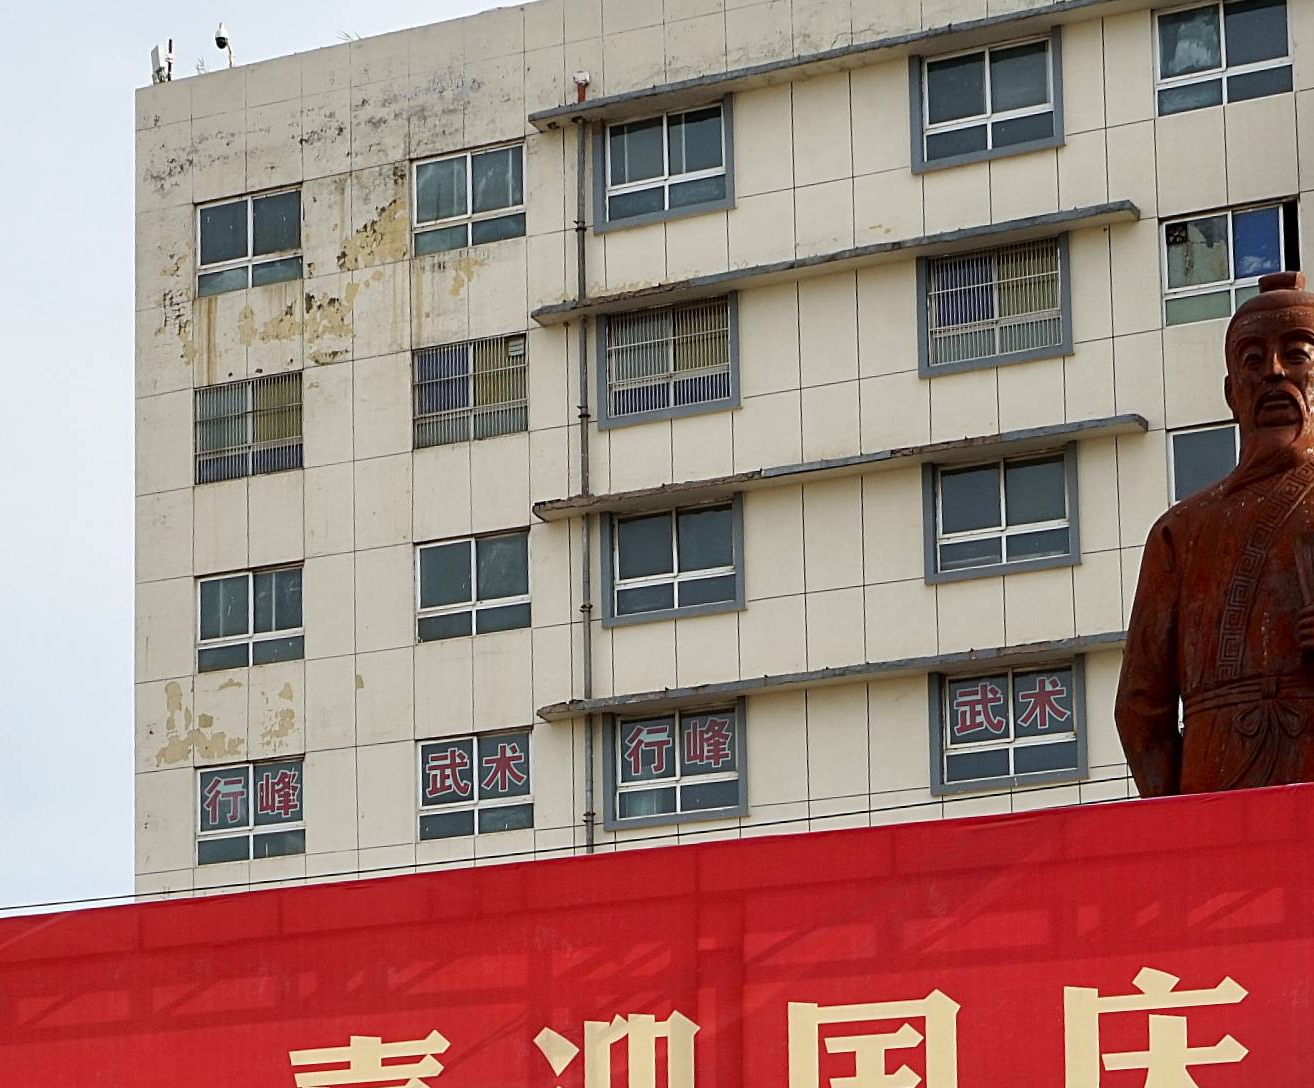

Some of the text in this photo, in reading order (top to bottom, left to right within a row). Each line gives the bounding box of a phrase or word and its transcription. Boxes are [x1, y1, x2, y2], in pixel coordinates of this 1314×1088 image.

[953, 675, 1073, 737] 武术
[425, 743, 528, 799] 武术
[624, 717, 733, 776] 行峰
[202, 768, 302, 826] 行峰
